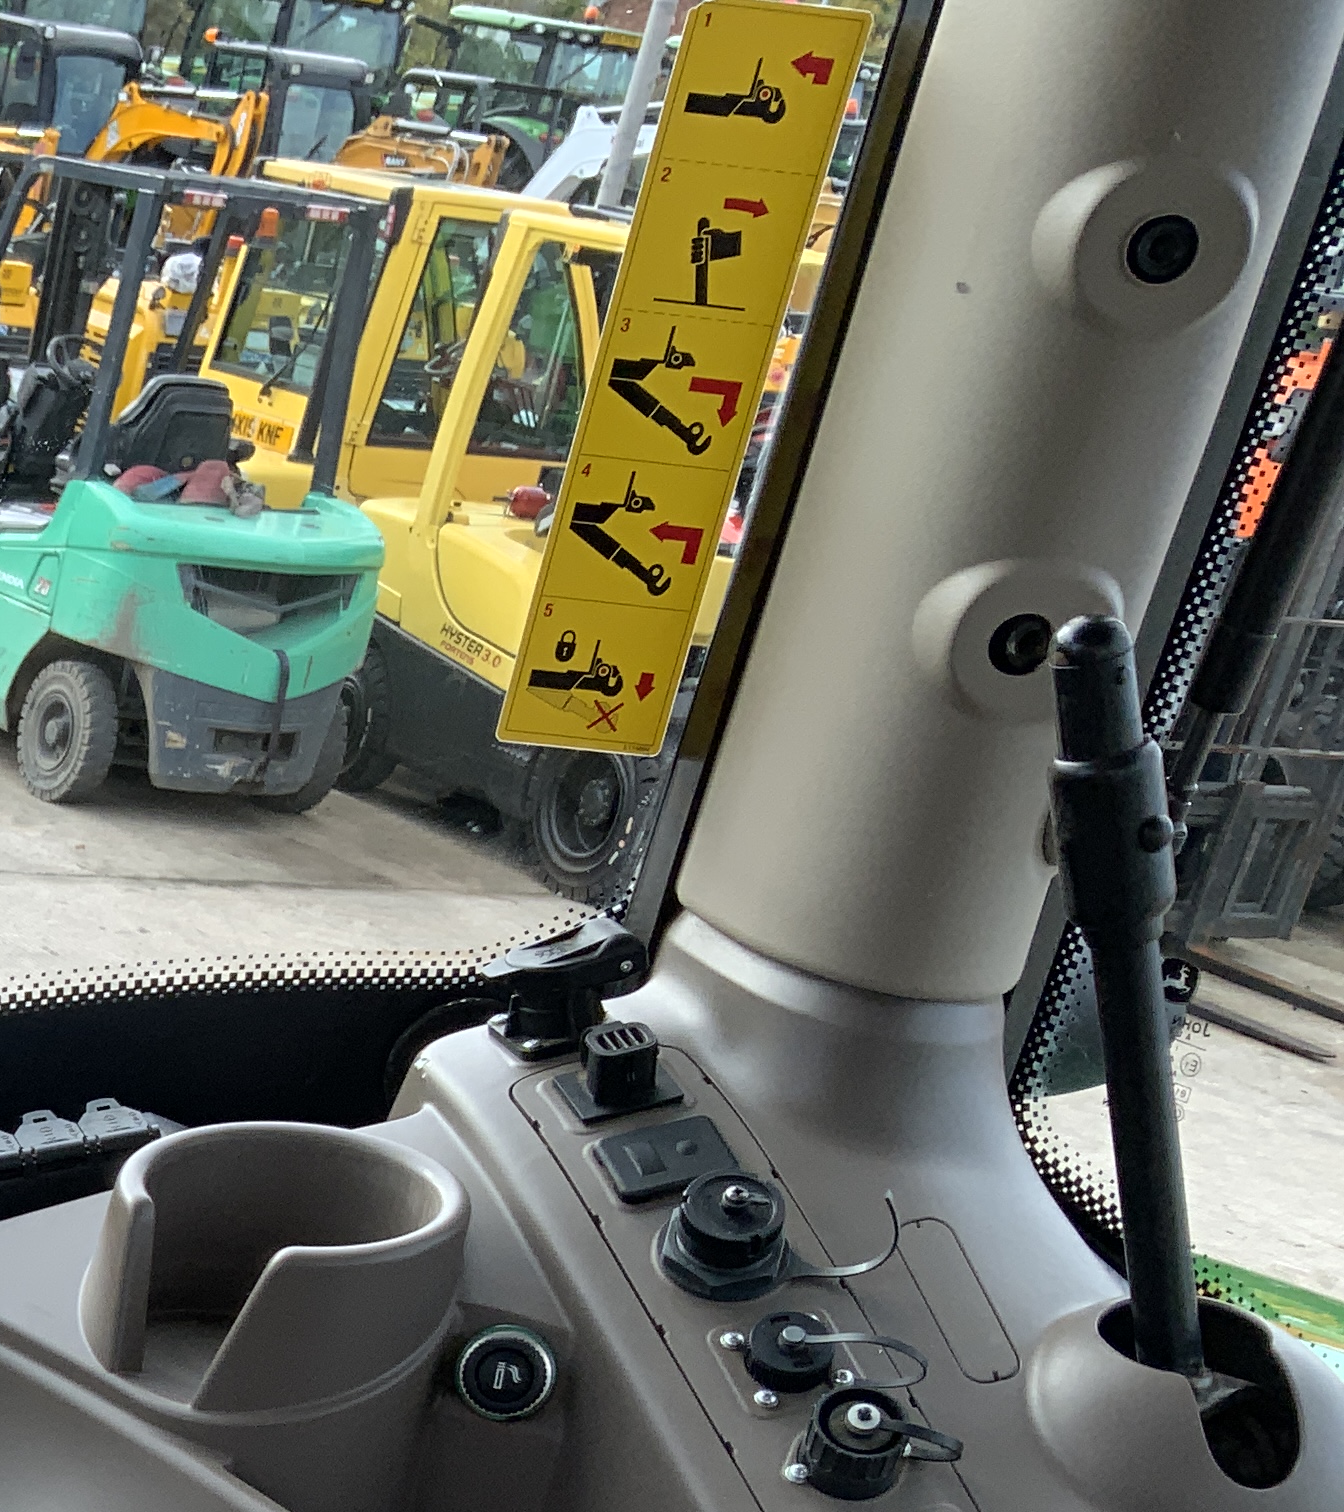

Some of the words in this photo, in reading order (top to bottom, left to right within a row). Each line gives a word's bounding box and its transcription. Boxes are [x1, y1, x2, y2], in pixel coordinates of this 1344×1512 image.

[705, 12, 712, 27] 1
[660, 167, 672, 183] 2
[620, 317, 632, 333] 3
[581, 463, 593, 479] 4
[543, 603, 555, 618] 5
[440, 622, 483, 657] HYSTER
[481, 648, 501, 668] 3.0
